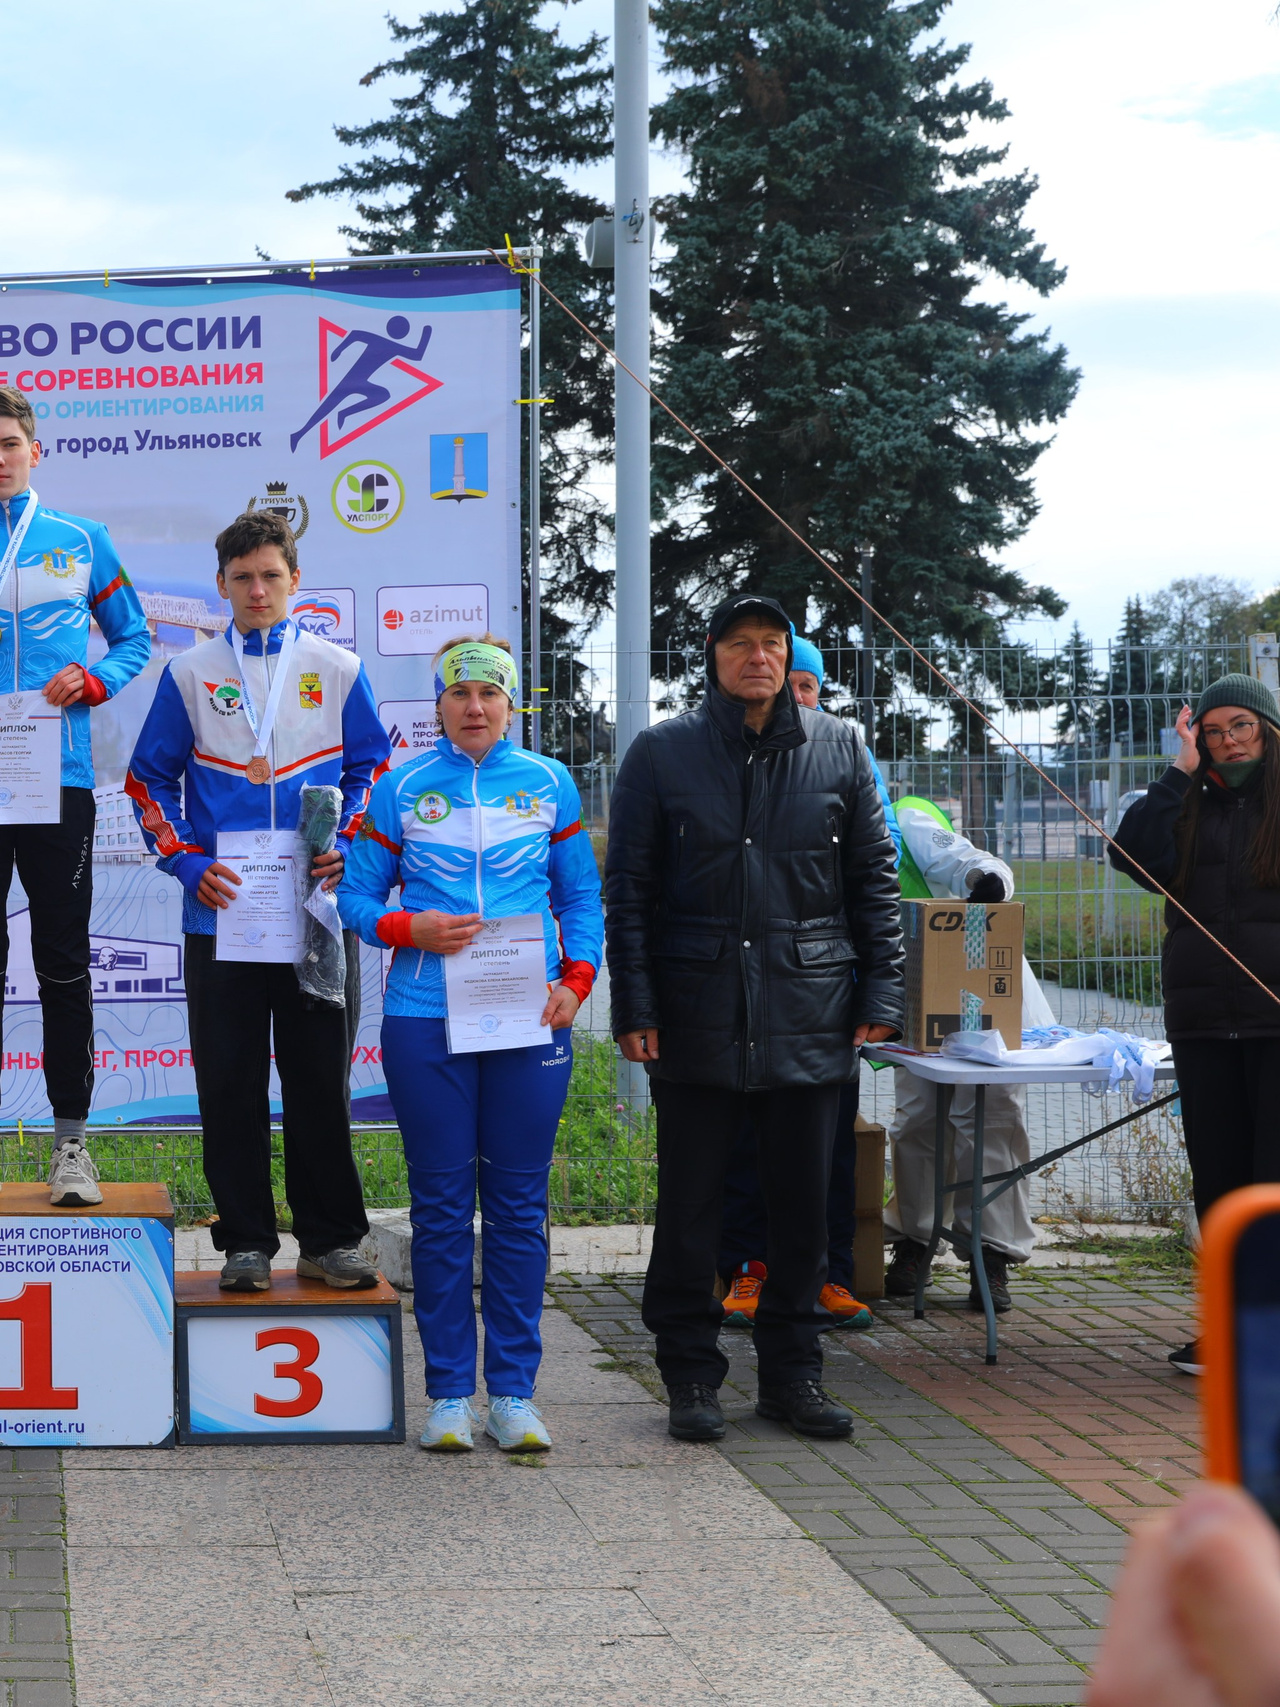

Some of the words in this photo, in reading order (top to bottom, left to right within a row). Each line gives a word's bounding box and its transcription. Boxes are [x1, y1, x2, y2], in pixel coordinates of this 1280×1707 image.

[70, 315, 262, 355] РОССИИ
[16, 362, 263, 392] СОРЕВНОВАНИЯ
[55, 394, 264, 419] ОРИЕНТИРОВАНИЯ
[56, 436, 128, 459] город
[134, 429, 262, 451] Ульяновск
[260, 497, 295, 505] ТРИУМФ
[347, 513, 390, 522] УЛСПОРТ
[410, 605, 483, 623] azimut
[241, 864, 286, 873] ДИПЛОМ
[470, 948, 519, 959] ДИПЛОМ
[29, 1227, 142, 1240] СПОРТИВНОГО
[60, 1261, 131, 1273] ОБЛАСТИ
[253, 1326, 324, 1418] 3
